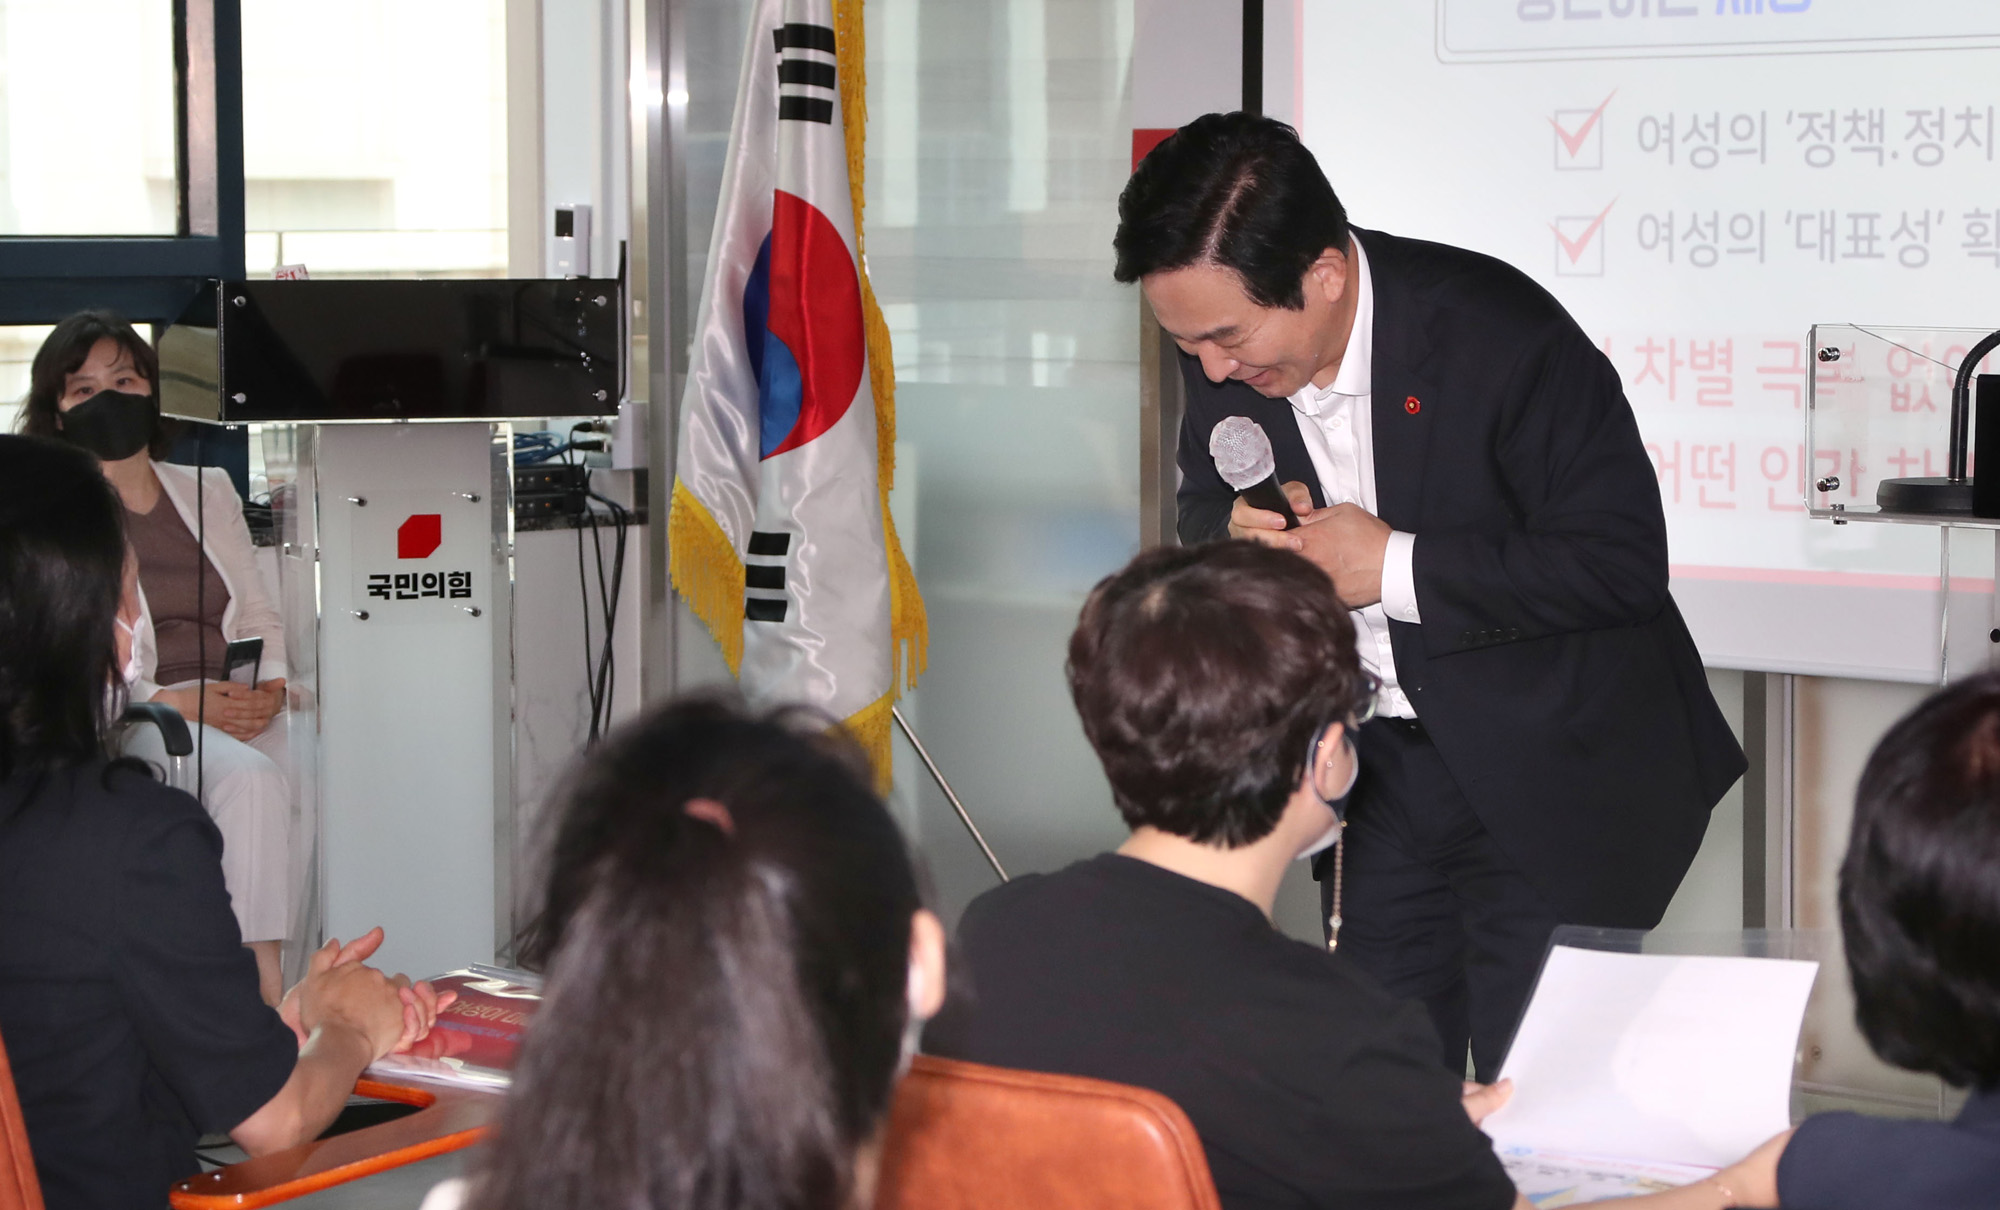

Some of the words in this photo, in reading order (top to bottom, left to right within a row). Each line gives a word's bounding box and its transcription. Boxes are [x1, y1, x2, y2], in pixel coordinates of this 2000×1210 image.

[1637, 109, 1766, 169] 여성의
[1637, 209, 1765, 268] 여성의
[1634, 336, 1734, 407] 차별
[367, 571, 472, 600] 국민의힘
